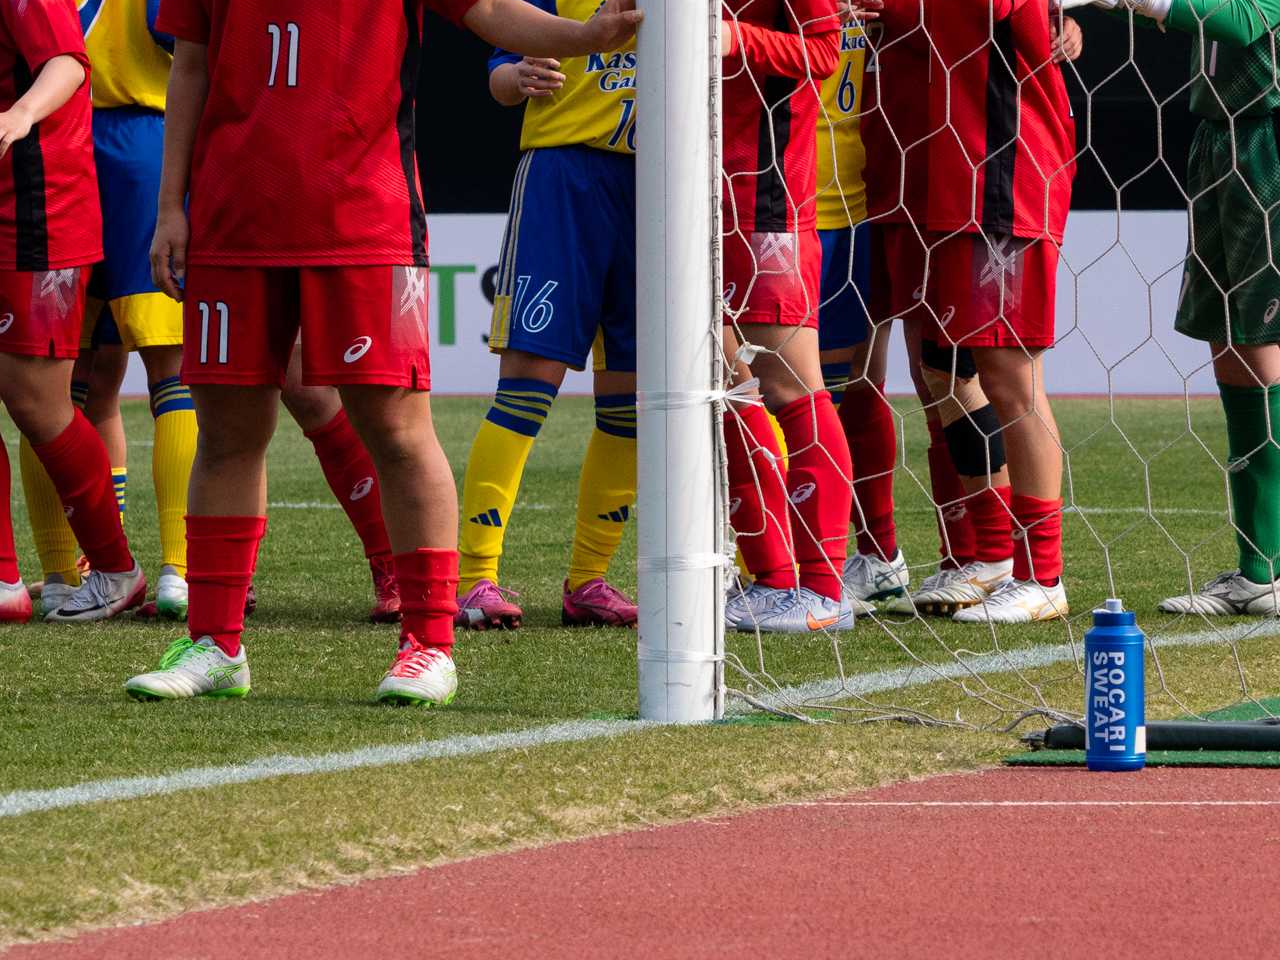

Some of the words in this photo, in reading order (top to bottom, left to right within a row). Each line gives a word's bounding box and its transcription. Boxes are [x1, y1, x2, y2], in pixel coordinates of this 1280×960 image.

[267, 22, 300, 87] 11
[836, 60, 856, 114] 6
[198, 301, 228, 364] 11
[513, 275, 559, 333] 16
[1093, 651, 1109, 743] SWEAT
[1108, 651, 1126, 752] POCARI
